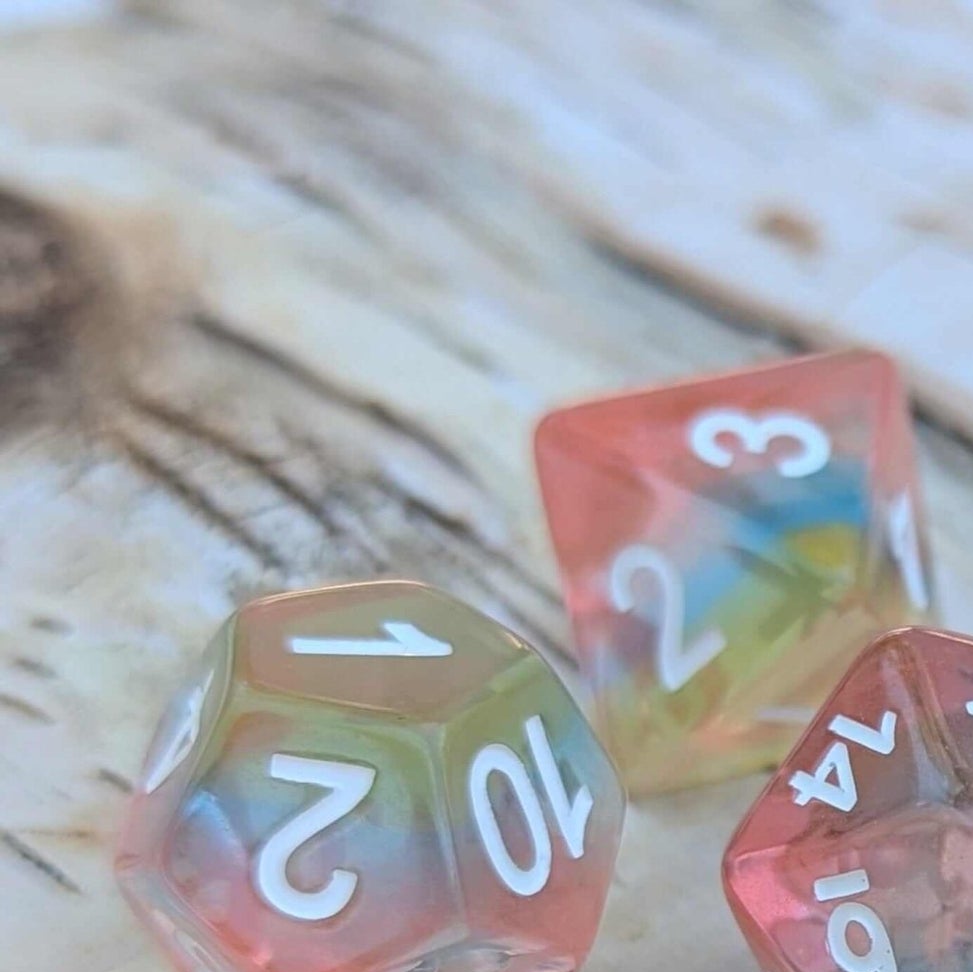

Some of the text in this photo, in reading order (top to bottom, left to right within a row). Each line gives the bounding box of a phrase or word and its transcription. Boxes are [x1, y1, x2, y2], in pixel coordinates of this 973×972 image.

[690, 410, 830, 478] 3
[291, 621, 452, 656] 1
[611, 545, 728, 692] 2
[470, 715, 593, 896] 10
[788, 711, 897, 812] 14
[259, 753, 376, 920] 2
